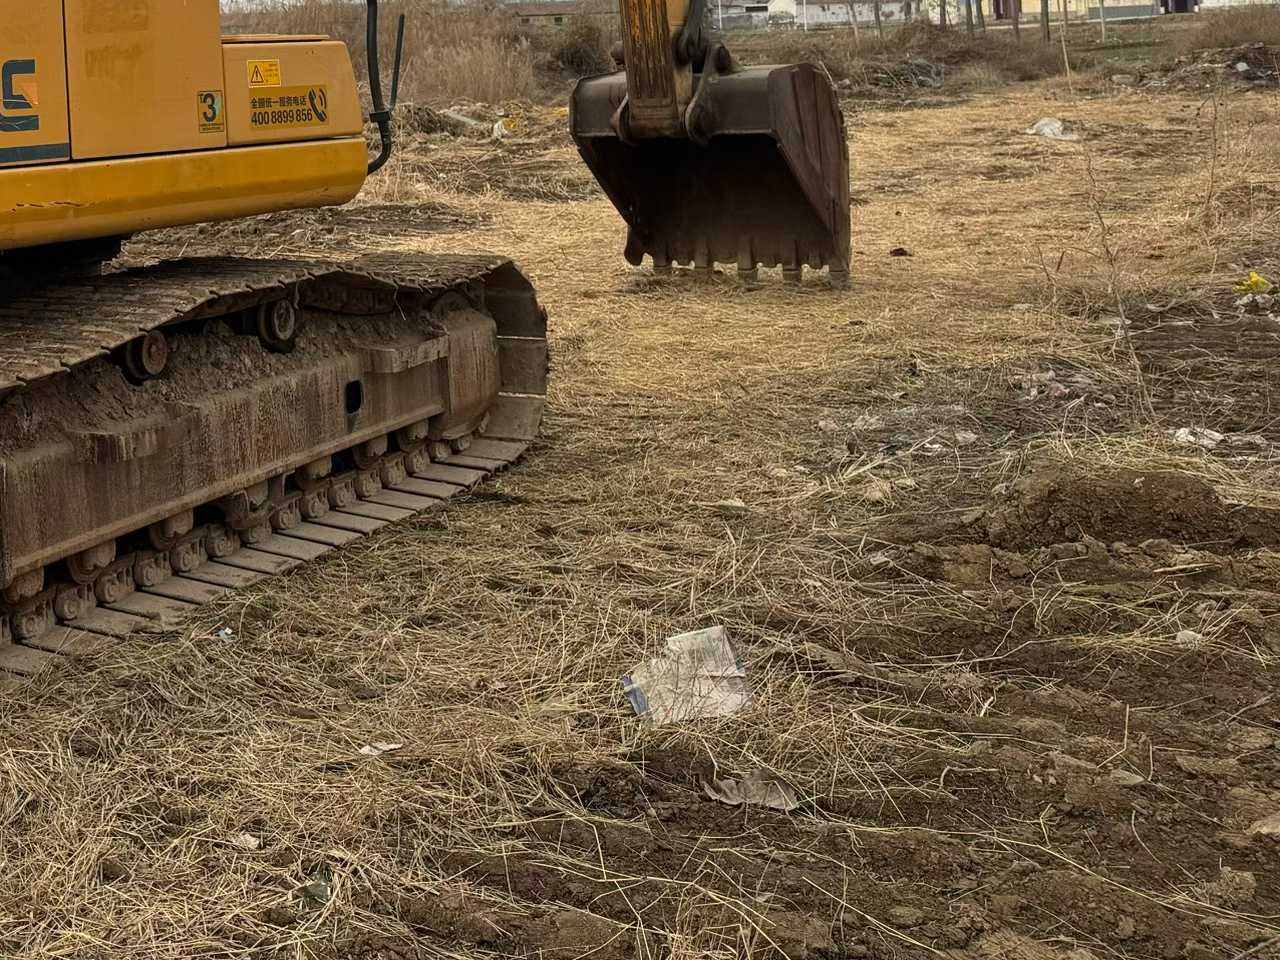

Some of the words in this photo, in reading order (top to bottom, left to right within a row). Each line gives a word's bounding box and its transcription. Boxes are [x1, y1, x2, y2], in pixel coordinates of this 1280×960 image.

[251, 110, 270, 126] 400
[271, 108, 295, 124] 8899
[295, 107, 313, 122] 856
